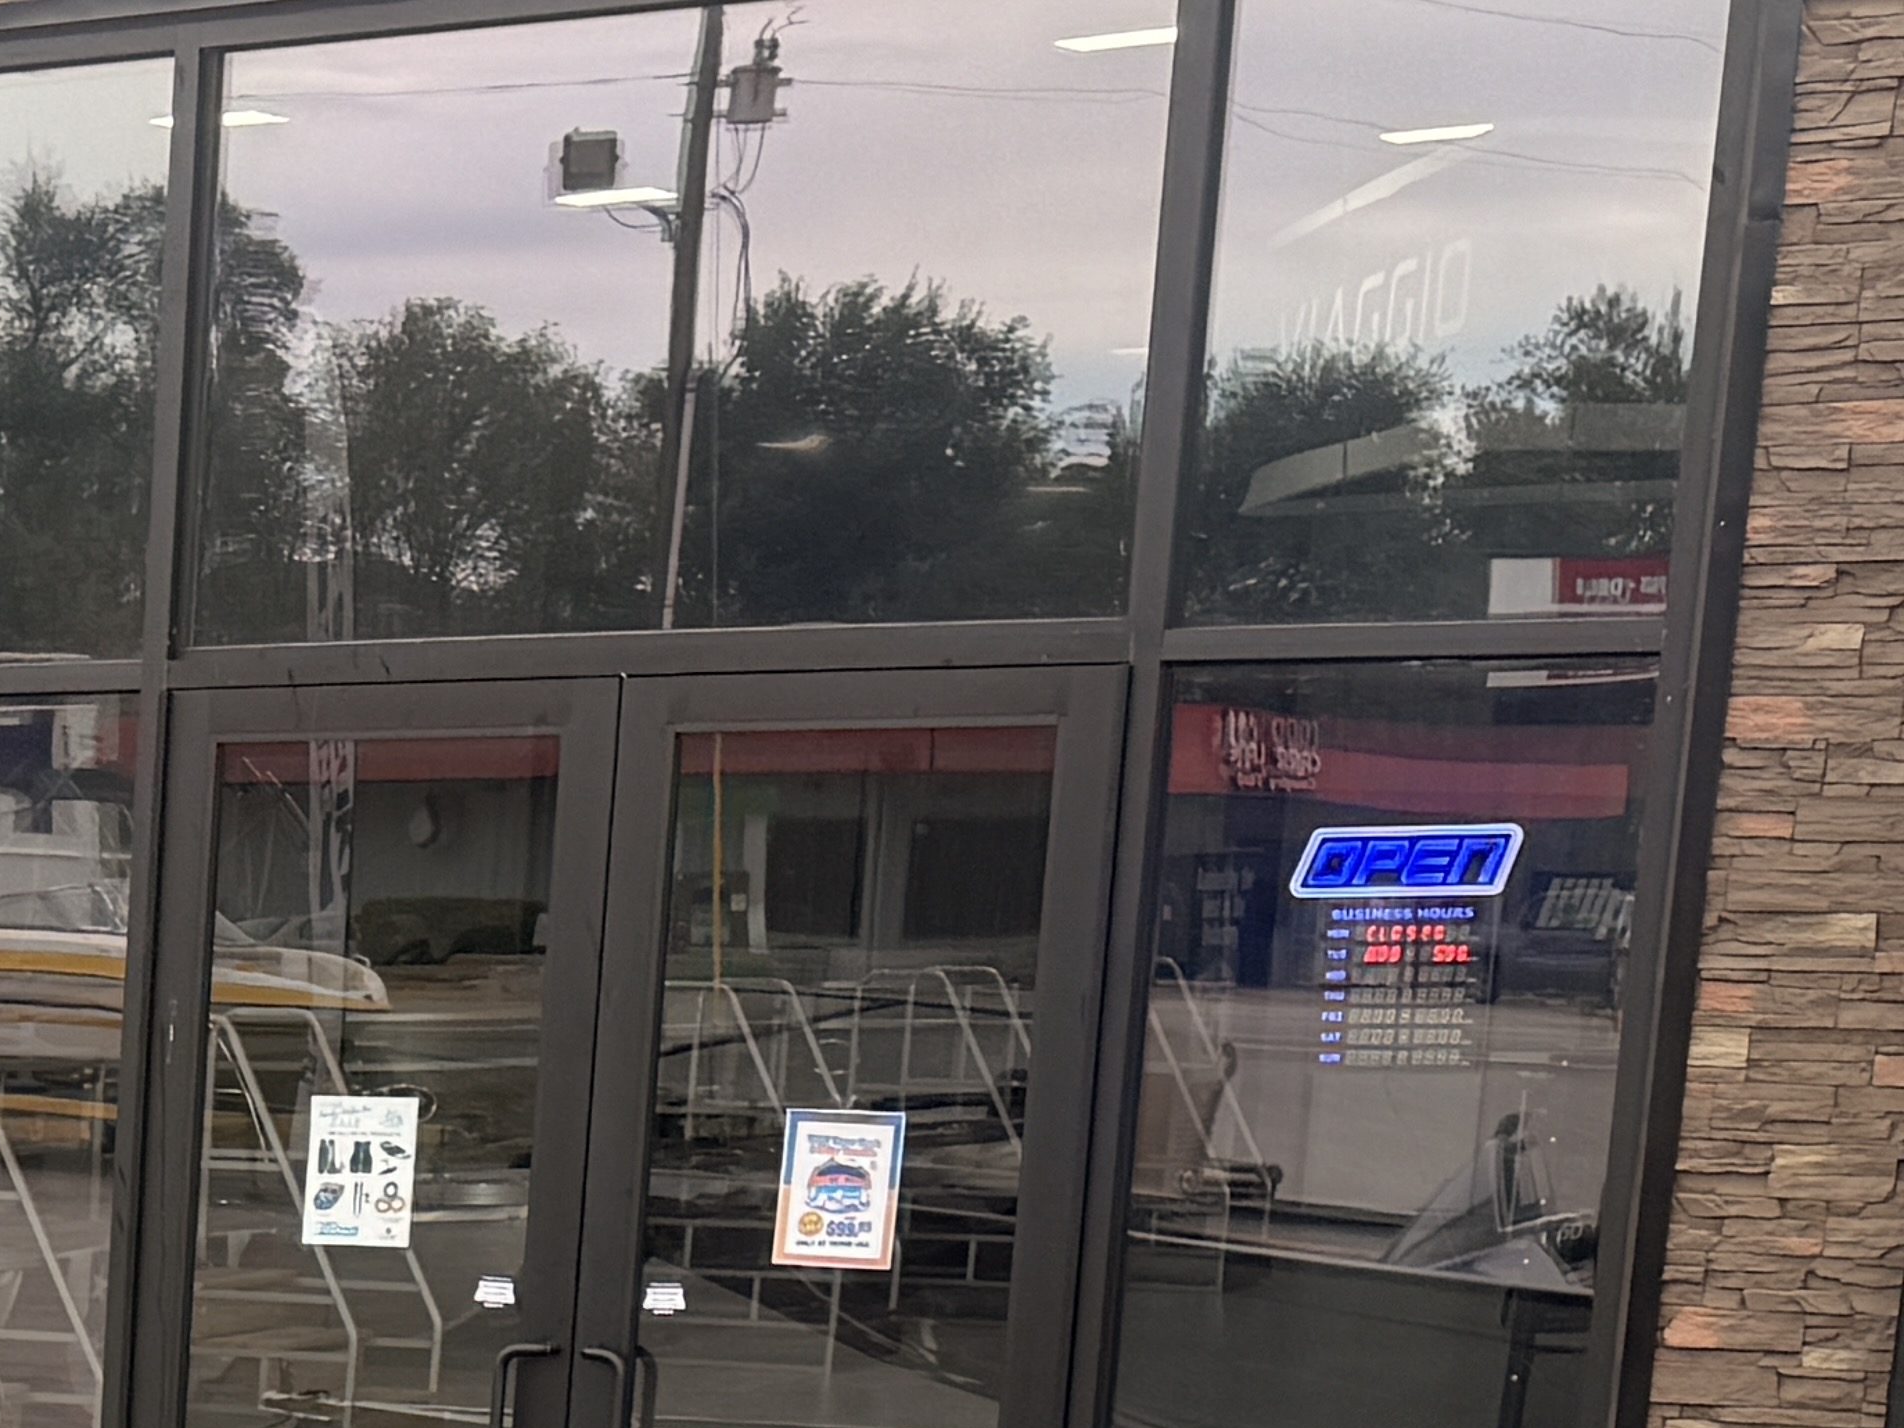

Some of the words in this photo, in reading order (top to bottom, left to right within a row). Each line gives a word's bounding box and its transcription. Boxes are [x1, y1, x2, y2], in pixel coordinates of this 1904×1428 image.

[1306, 837, 1506, 885] OPEN
[1331, 908, 1413, 921] BUSINESS
[1417, 906, 1475, 919] HOURS
[1365, 925, 1445, 942] CLOSED
